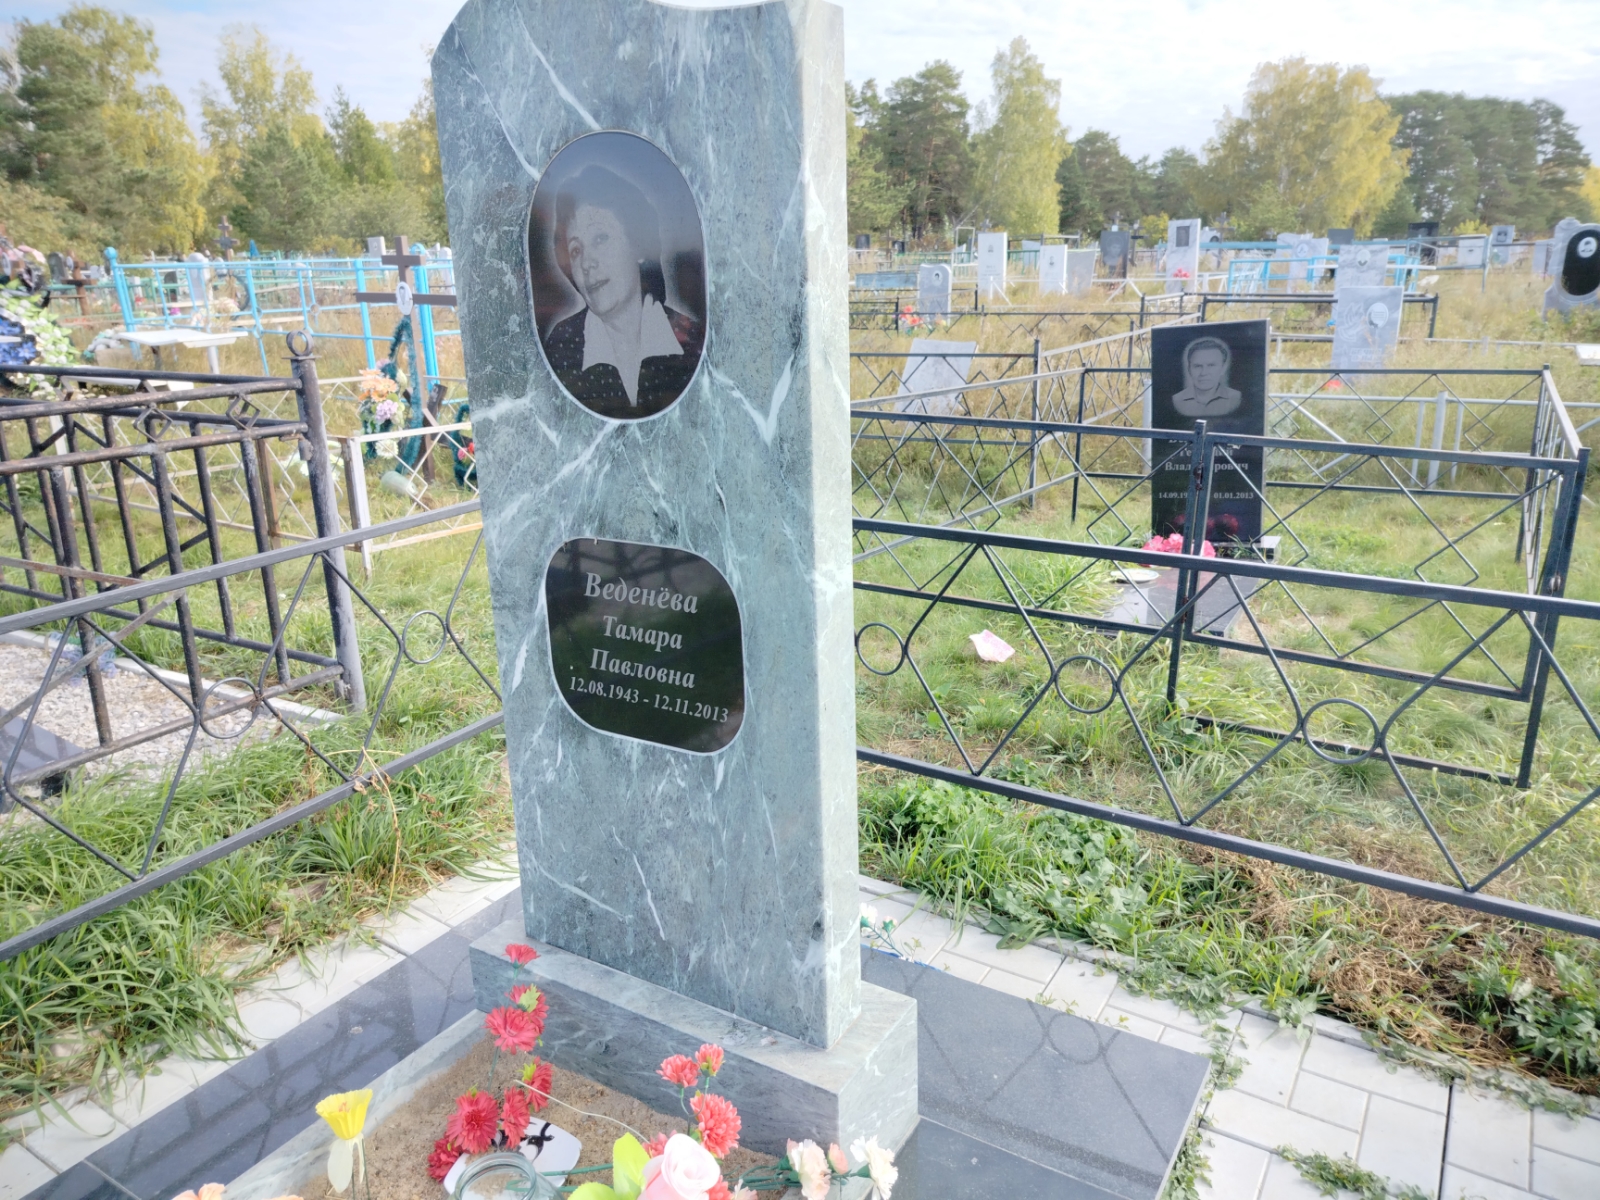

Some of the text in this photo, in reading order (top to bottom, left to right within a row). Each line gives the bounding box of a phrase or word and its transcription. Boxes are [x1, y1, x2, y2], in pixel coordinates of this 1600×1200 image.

[583, 571, 699, 614] Веденёва
[602, 615, 683, 652] Тамара
[589, 648, 696, 689] Павловна
[569, 676, 640, 704] 12.08.1943
[653, 693, 729, 723] 12.11.2013
